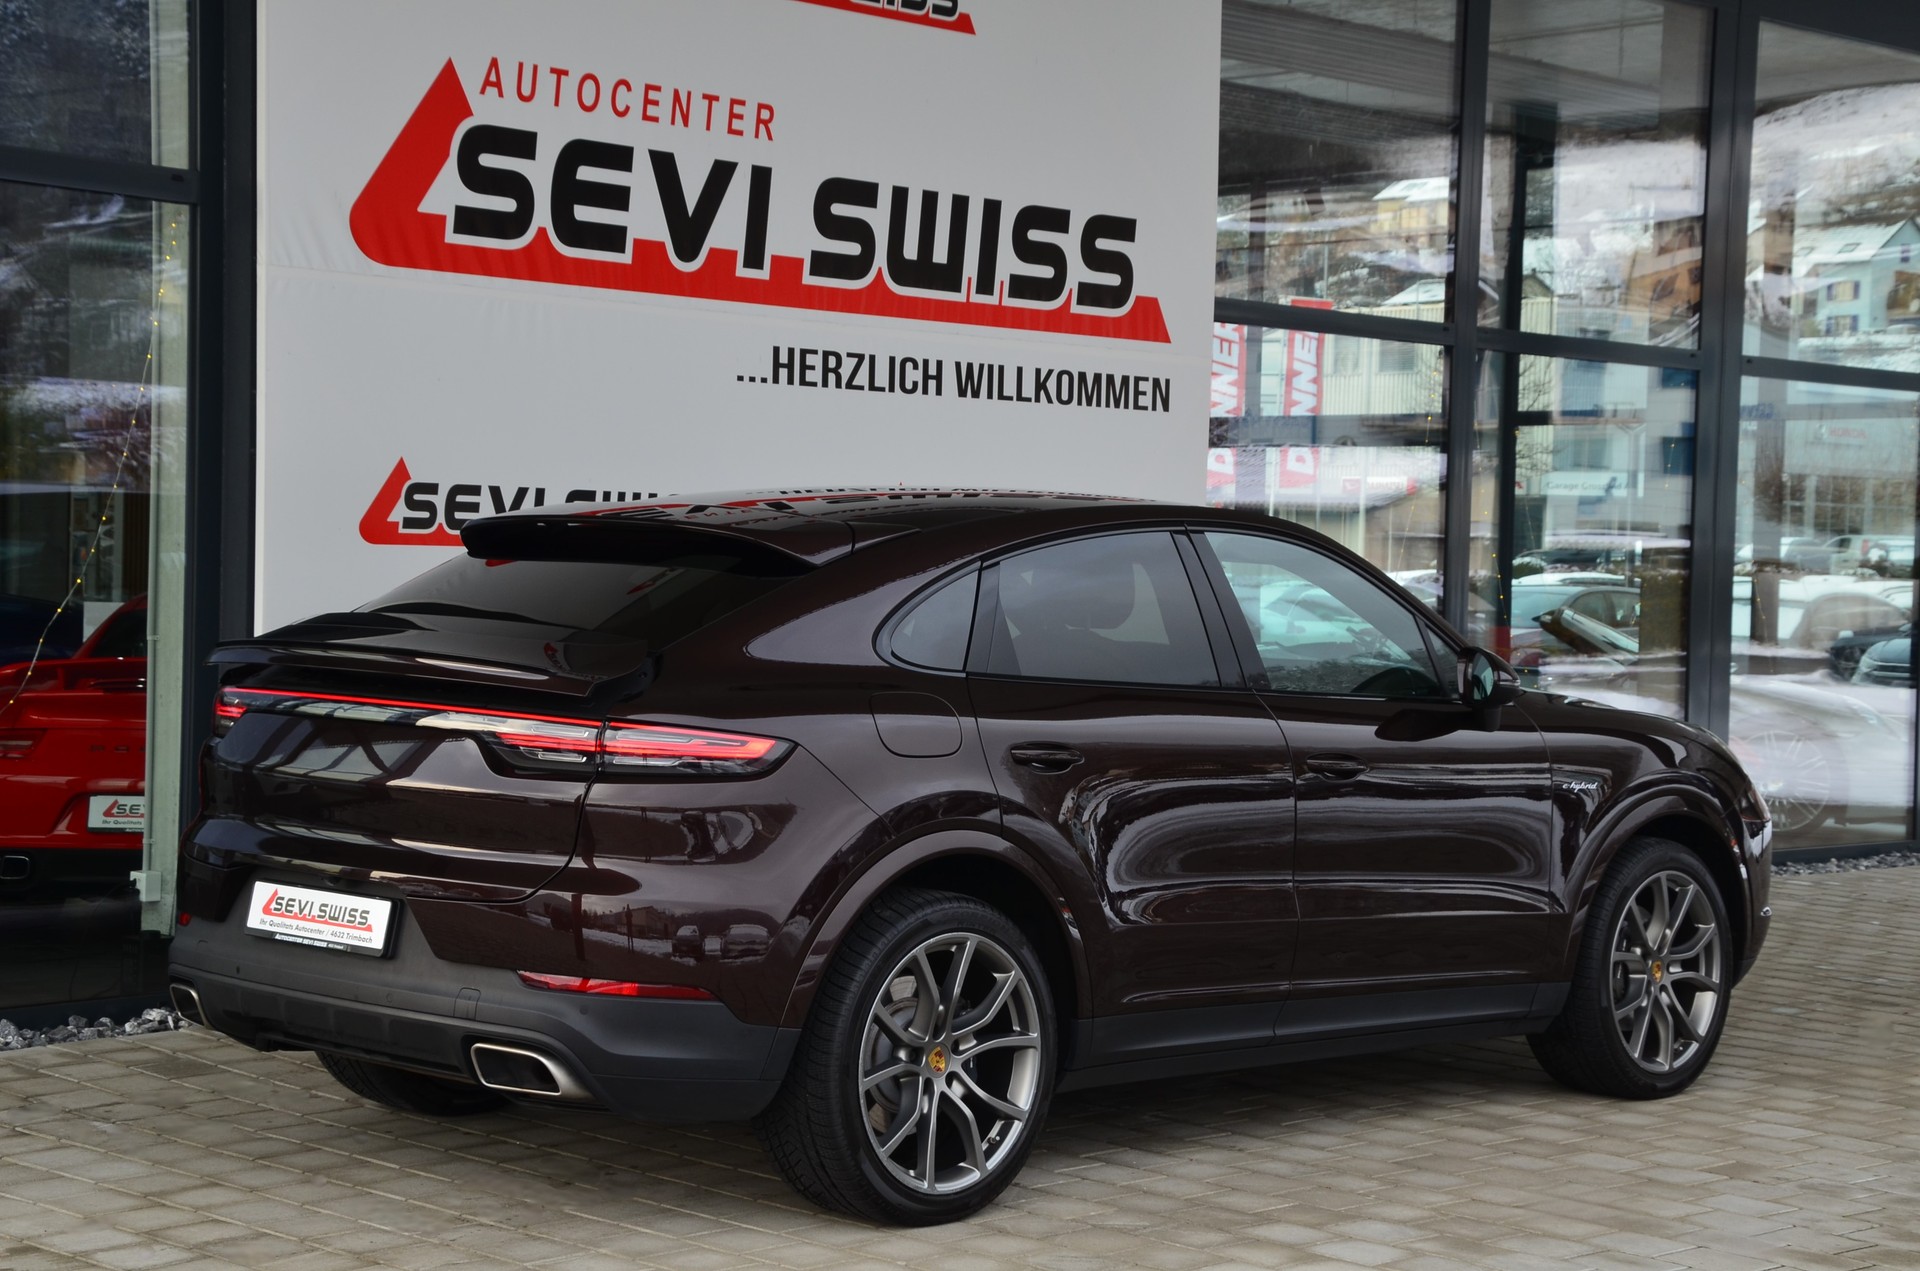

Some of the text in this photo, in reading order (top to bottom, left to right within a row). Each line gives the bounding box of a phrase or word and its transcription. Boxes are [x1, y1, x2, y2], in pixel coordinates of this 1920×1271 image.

[479, 56, 776, 142] AUTOCENTER
[452, 124, 1137, 310] SEVI SWISS
[736, 345, 1171, 413] ...HERZLICH WILLKOMMEN
[259, 918, 268, 926] Ihr
[294, 924, 325, 936] Autocenter
[330, 930, 345, 939] 4632
[345, 932, 373, 944] Trimbach
[273, 896, 370, 926] SEVI SWISS
